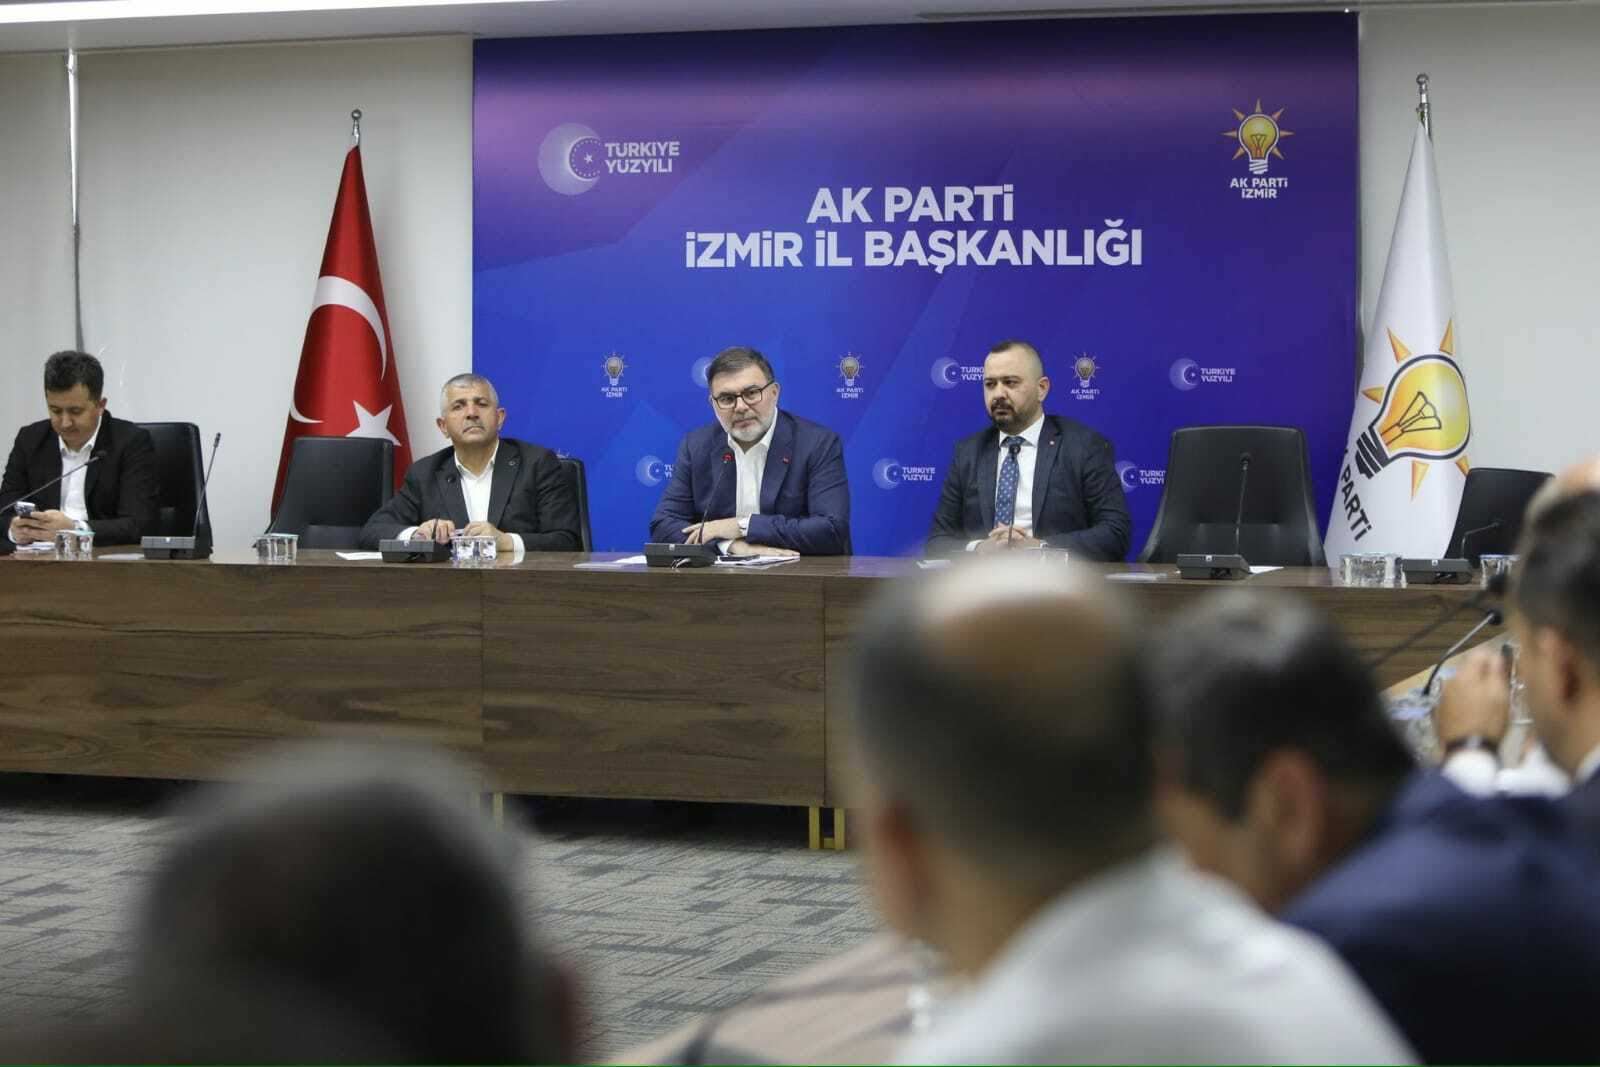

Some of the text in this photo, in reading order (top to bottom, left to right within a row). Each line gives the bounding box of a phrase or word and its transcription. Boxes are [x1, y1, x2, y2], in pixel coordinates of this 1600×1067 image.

[1230, 177, 1248, 188] AK
[806, 183, 1014, 223] AK PARTİ
[685, 230, 803, 268] İZMİR
[864, 218, 1143, 274] BAŞKANLIĞI
